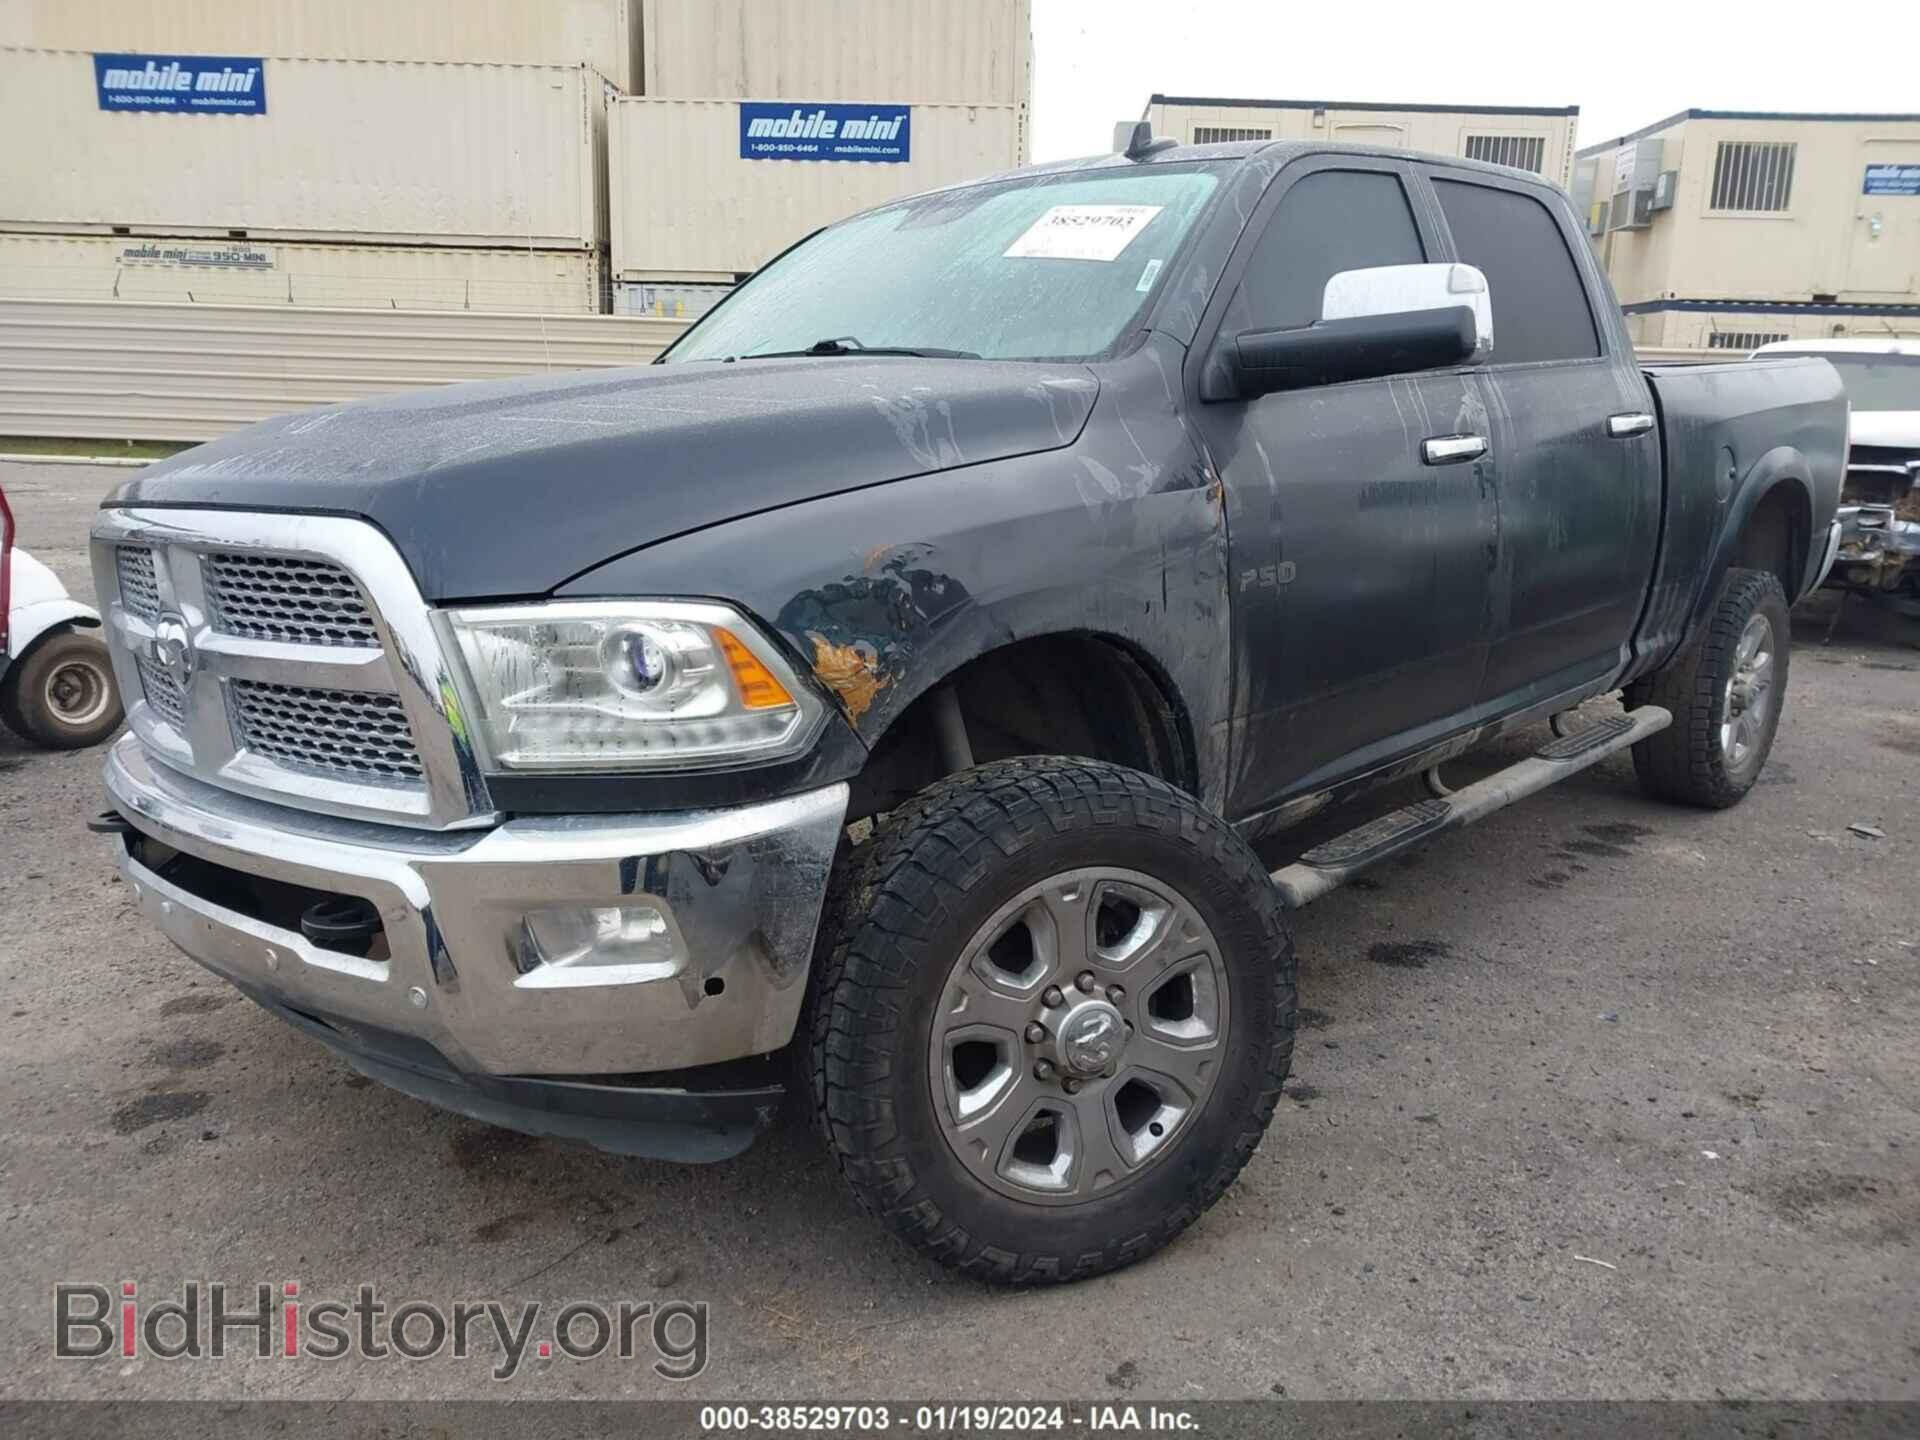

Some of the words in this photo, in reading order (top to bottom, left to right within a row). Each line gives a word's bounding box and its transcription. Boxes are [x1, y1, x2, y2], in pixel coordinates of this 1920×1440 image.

[103, 61, 192, 91] mobile
[195, 67, 256, 92] mini
[747, 109, 838, 138] mobile
[840, 115, 903, 140] mini
[834, 145, 901, 154] mobilemini.com
[123, 244, 161, 258] mobile
[163, 247, 188, 259] mini
